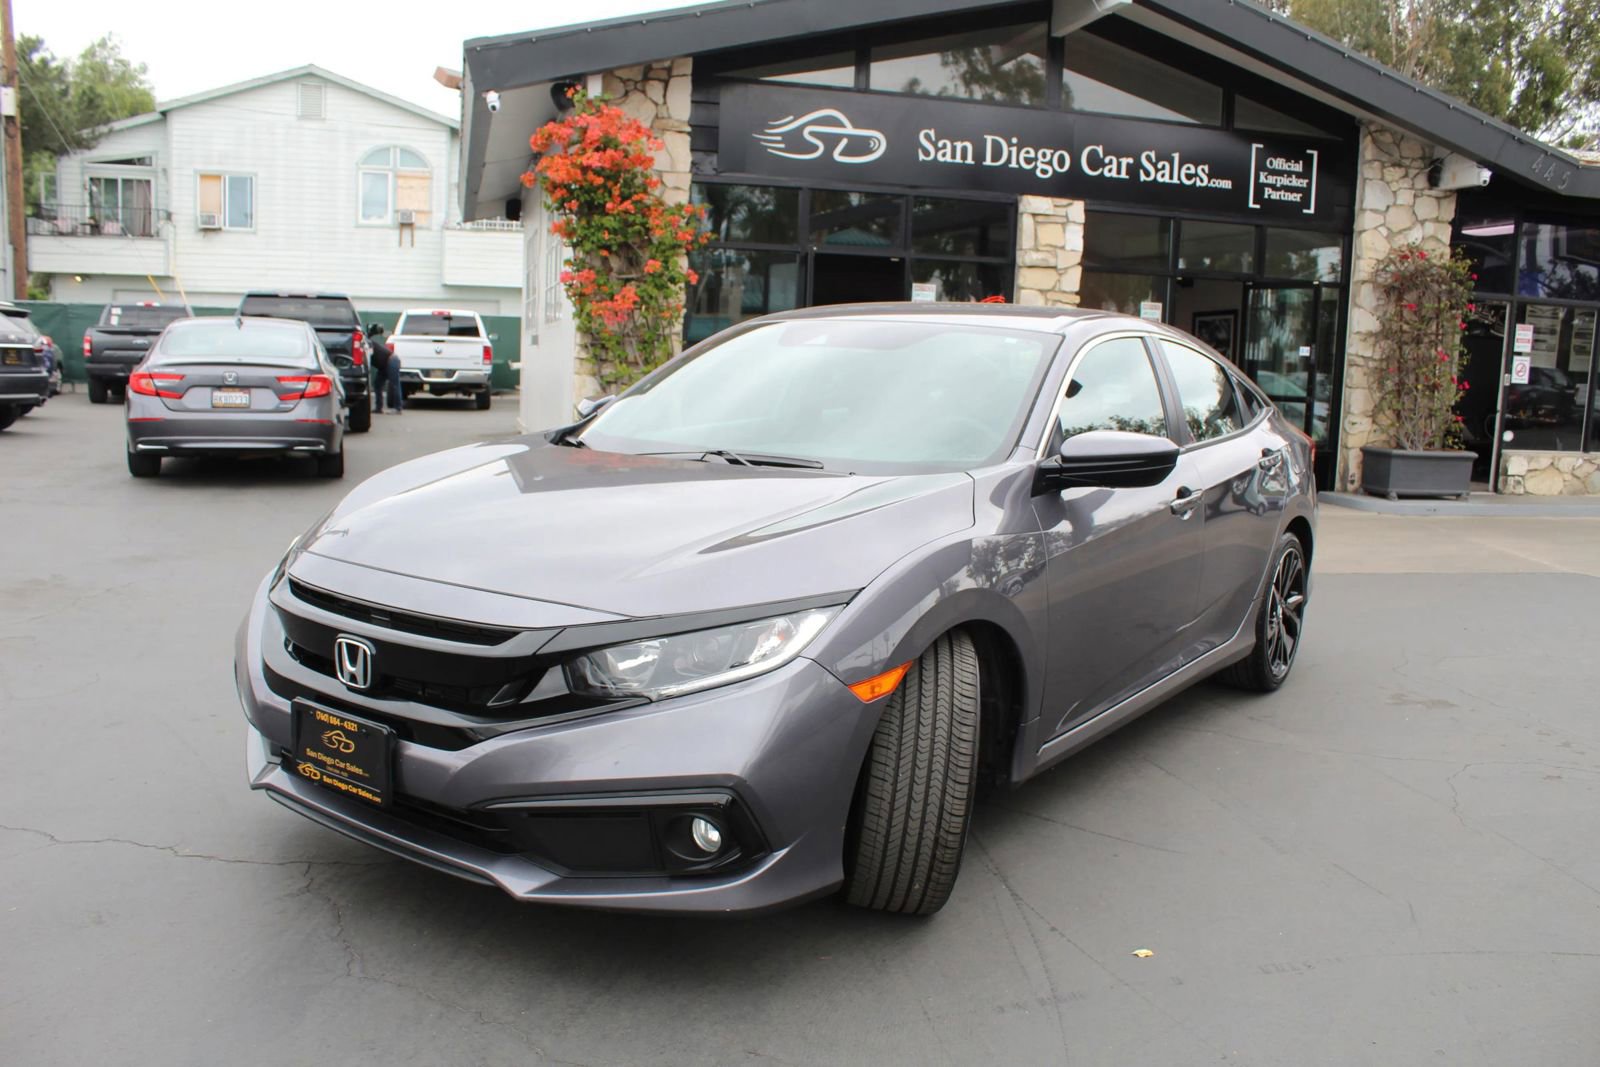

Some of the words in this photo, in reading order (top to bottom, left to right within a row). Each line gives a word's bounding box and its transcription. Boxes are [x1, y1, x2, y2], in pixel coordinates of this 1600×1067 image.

[917, 128, 975, 165] San
[982, 134, 1071, 179] Diego
[1080, 144, 1134, 180] Car
[1266, 156, 1303, 172] Official
[1259, 171, 1309, 188] Karpicker
[1263, 186, 1303, 203] Partner
[306, 748, 317, 758] San
[317, 752, 335, 765] Diego
[335, 758, 346, 769] Car
[322, 775, 333, 784] San
[348, 784, 358, 794] Car
